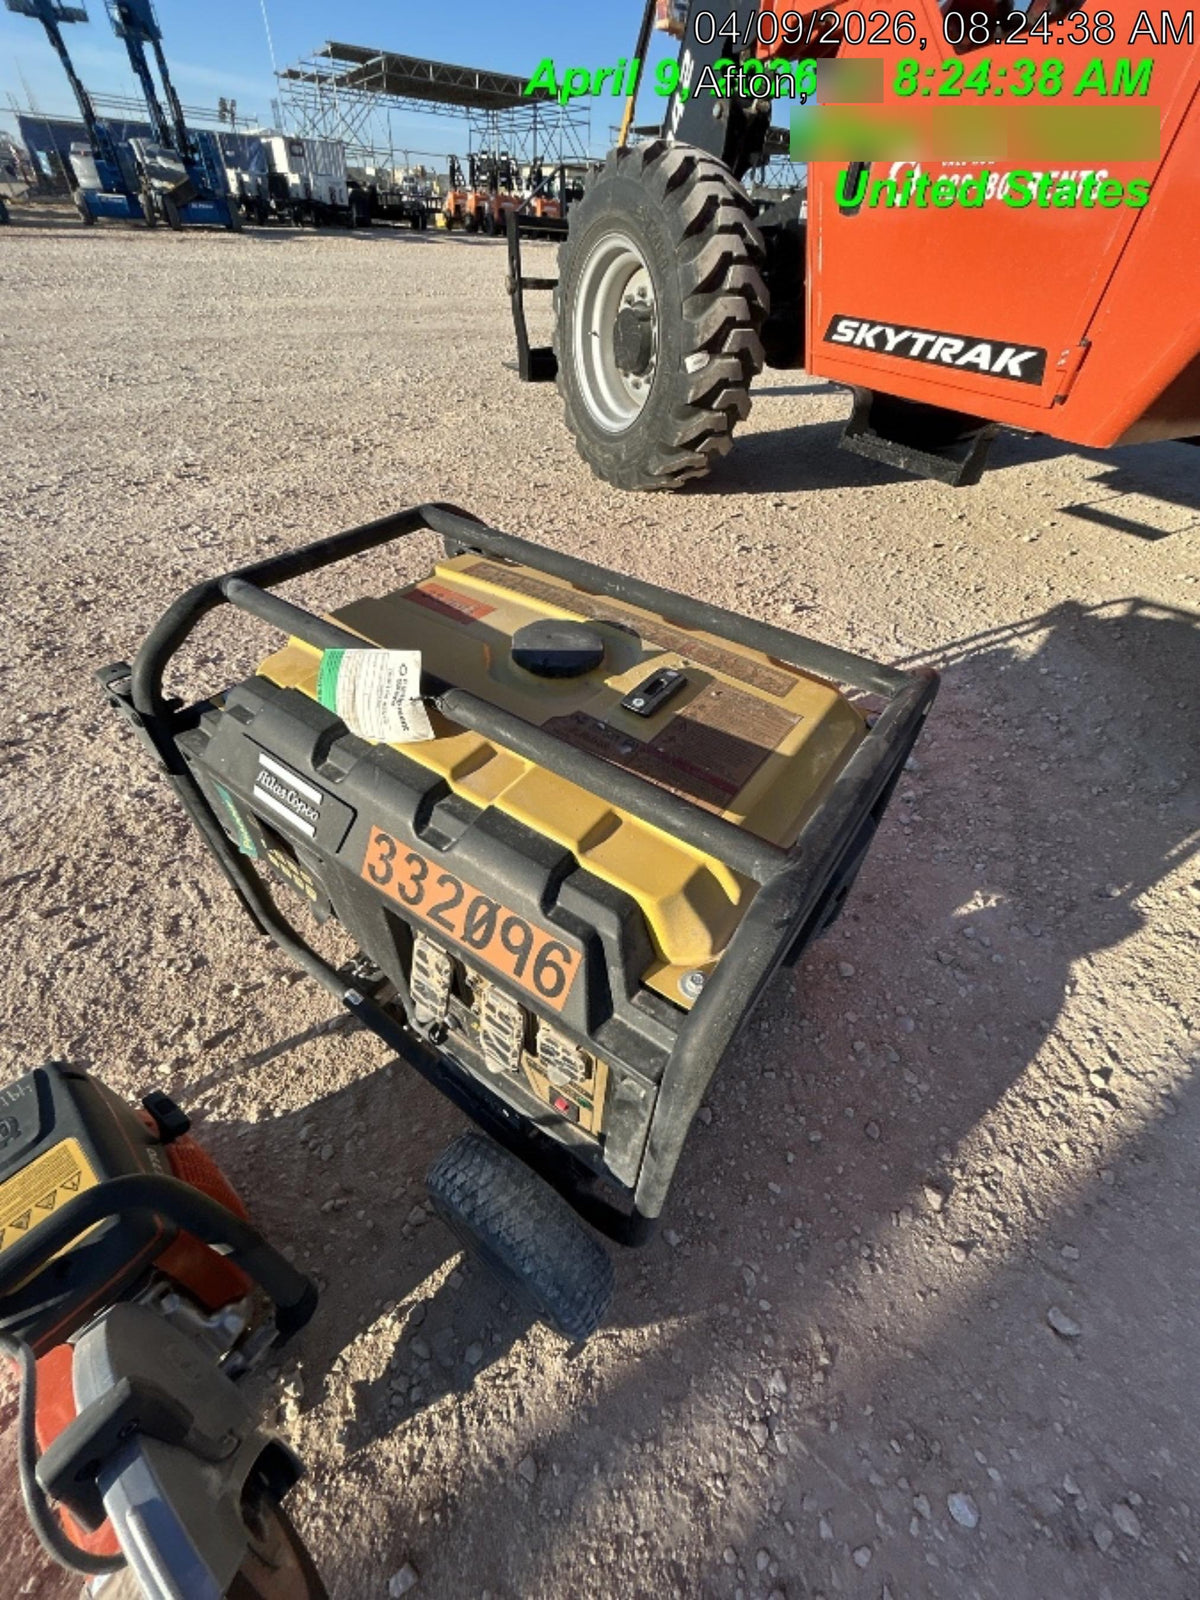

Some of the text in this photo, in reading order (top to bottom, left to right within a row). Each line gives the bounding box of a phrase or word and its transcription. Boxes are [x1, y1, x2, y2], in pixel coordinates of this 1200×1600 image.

[831, 319, 1039, 378] SKYTRAK
[256, 769, 320, 823] Atlas Copco
